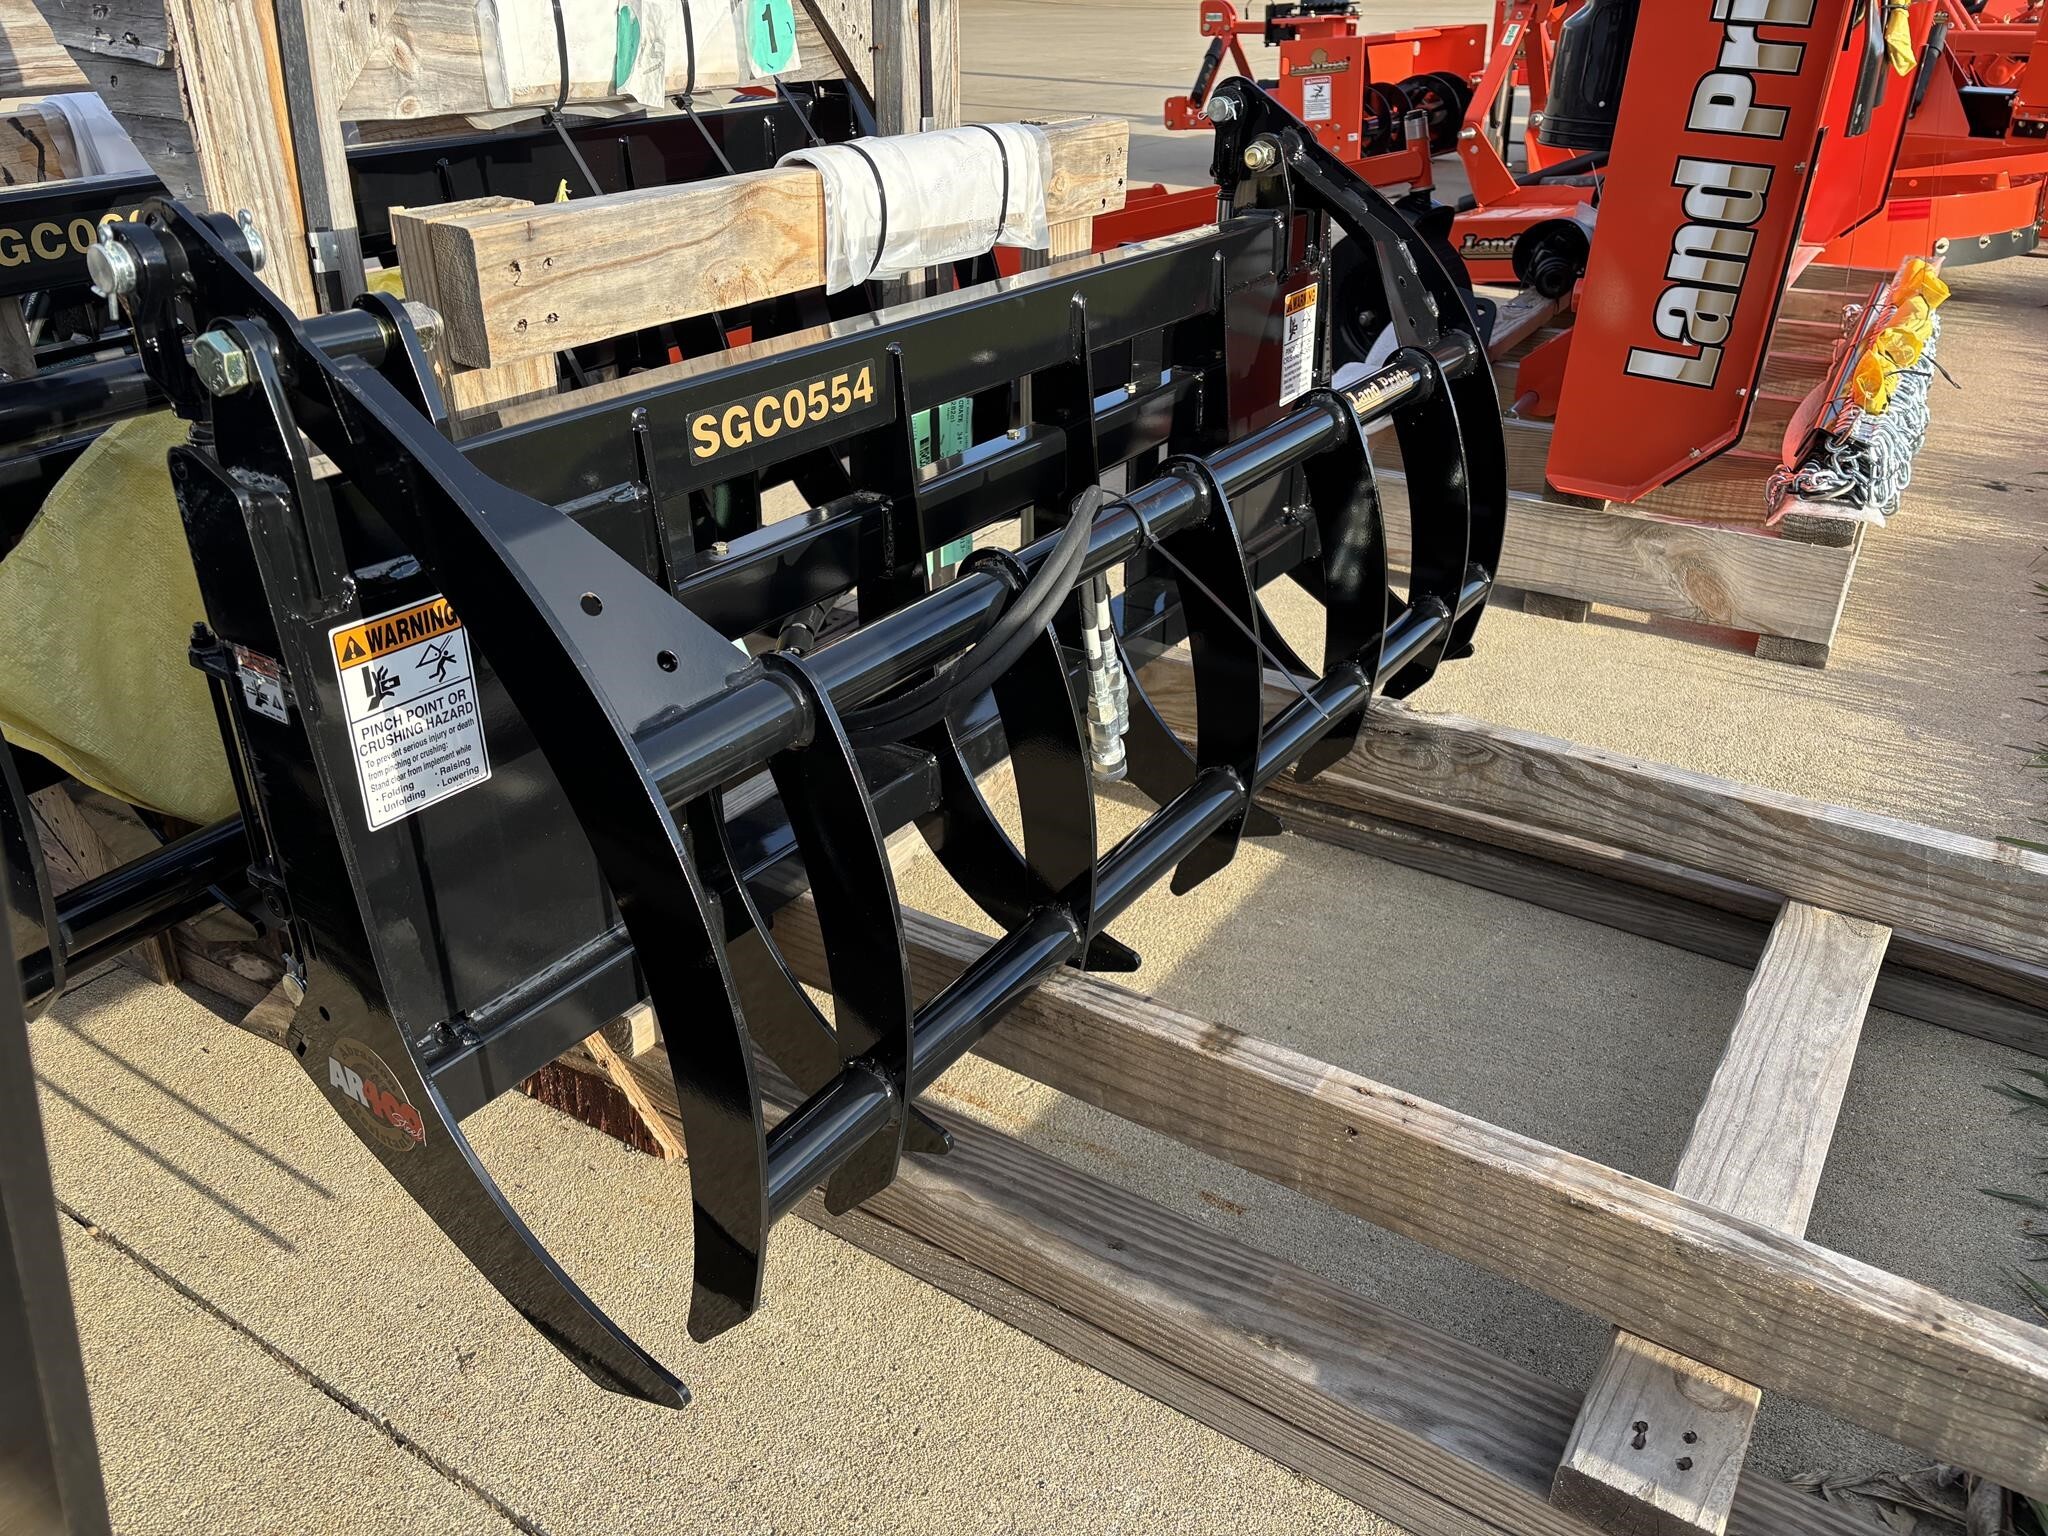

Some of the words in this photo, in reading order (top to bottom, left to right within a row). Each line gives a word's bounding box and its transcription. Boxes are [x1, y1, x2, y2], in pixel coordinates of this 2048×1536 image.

[761, 3, 778, 54] 1
[1461, 234, 1520, 254] Land
[1624, 155, 1775, 390] Land
[692, 366, 874, 458] SGC0554
[1346, 381, 1382, 408] Land
[1377, 369, 1412, 391] Pride
[364, 602, 458, 653] WARNING
[360, 722, 424, 757] CRUSHING
[426, 701, 473, 730] HAZARD
[361, 713, 403, 740] PINCH
[406, 697, 444, 722] POINT
[448, 688, 467, 705] OR
[366, 759, 375, 769] To
[376, 749, 402, 766] prevent
[403, 738, 428, 754] serious
[429, 730, 448, 744] injury
[448, 726, 456, 735] or
[457, 718, 475, 732] death
[368, 769, 384, 782] from
[384, 757, 412, 776] pinching
[412, 752, 419, 762] or
[420, 742, 449, 760] crushing:
[370, 780, 390, 793] Stand
[391, 773, 406, 784] clear
[407, 765, 423, 779] from
[423, 750, 455, 772] implement
[455, 743, 472, 756] while
[440, 756, 471, 776] Raising
[381, 781, 415, 802] Folding
[383, 788, 426, 814] Unfolding
[442, 765, 480, 787] Lowering
